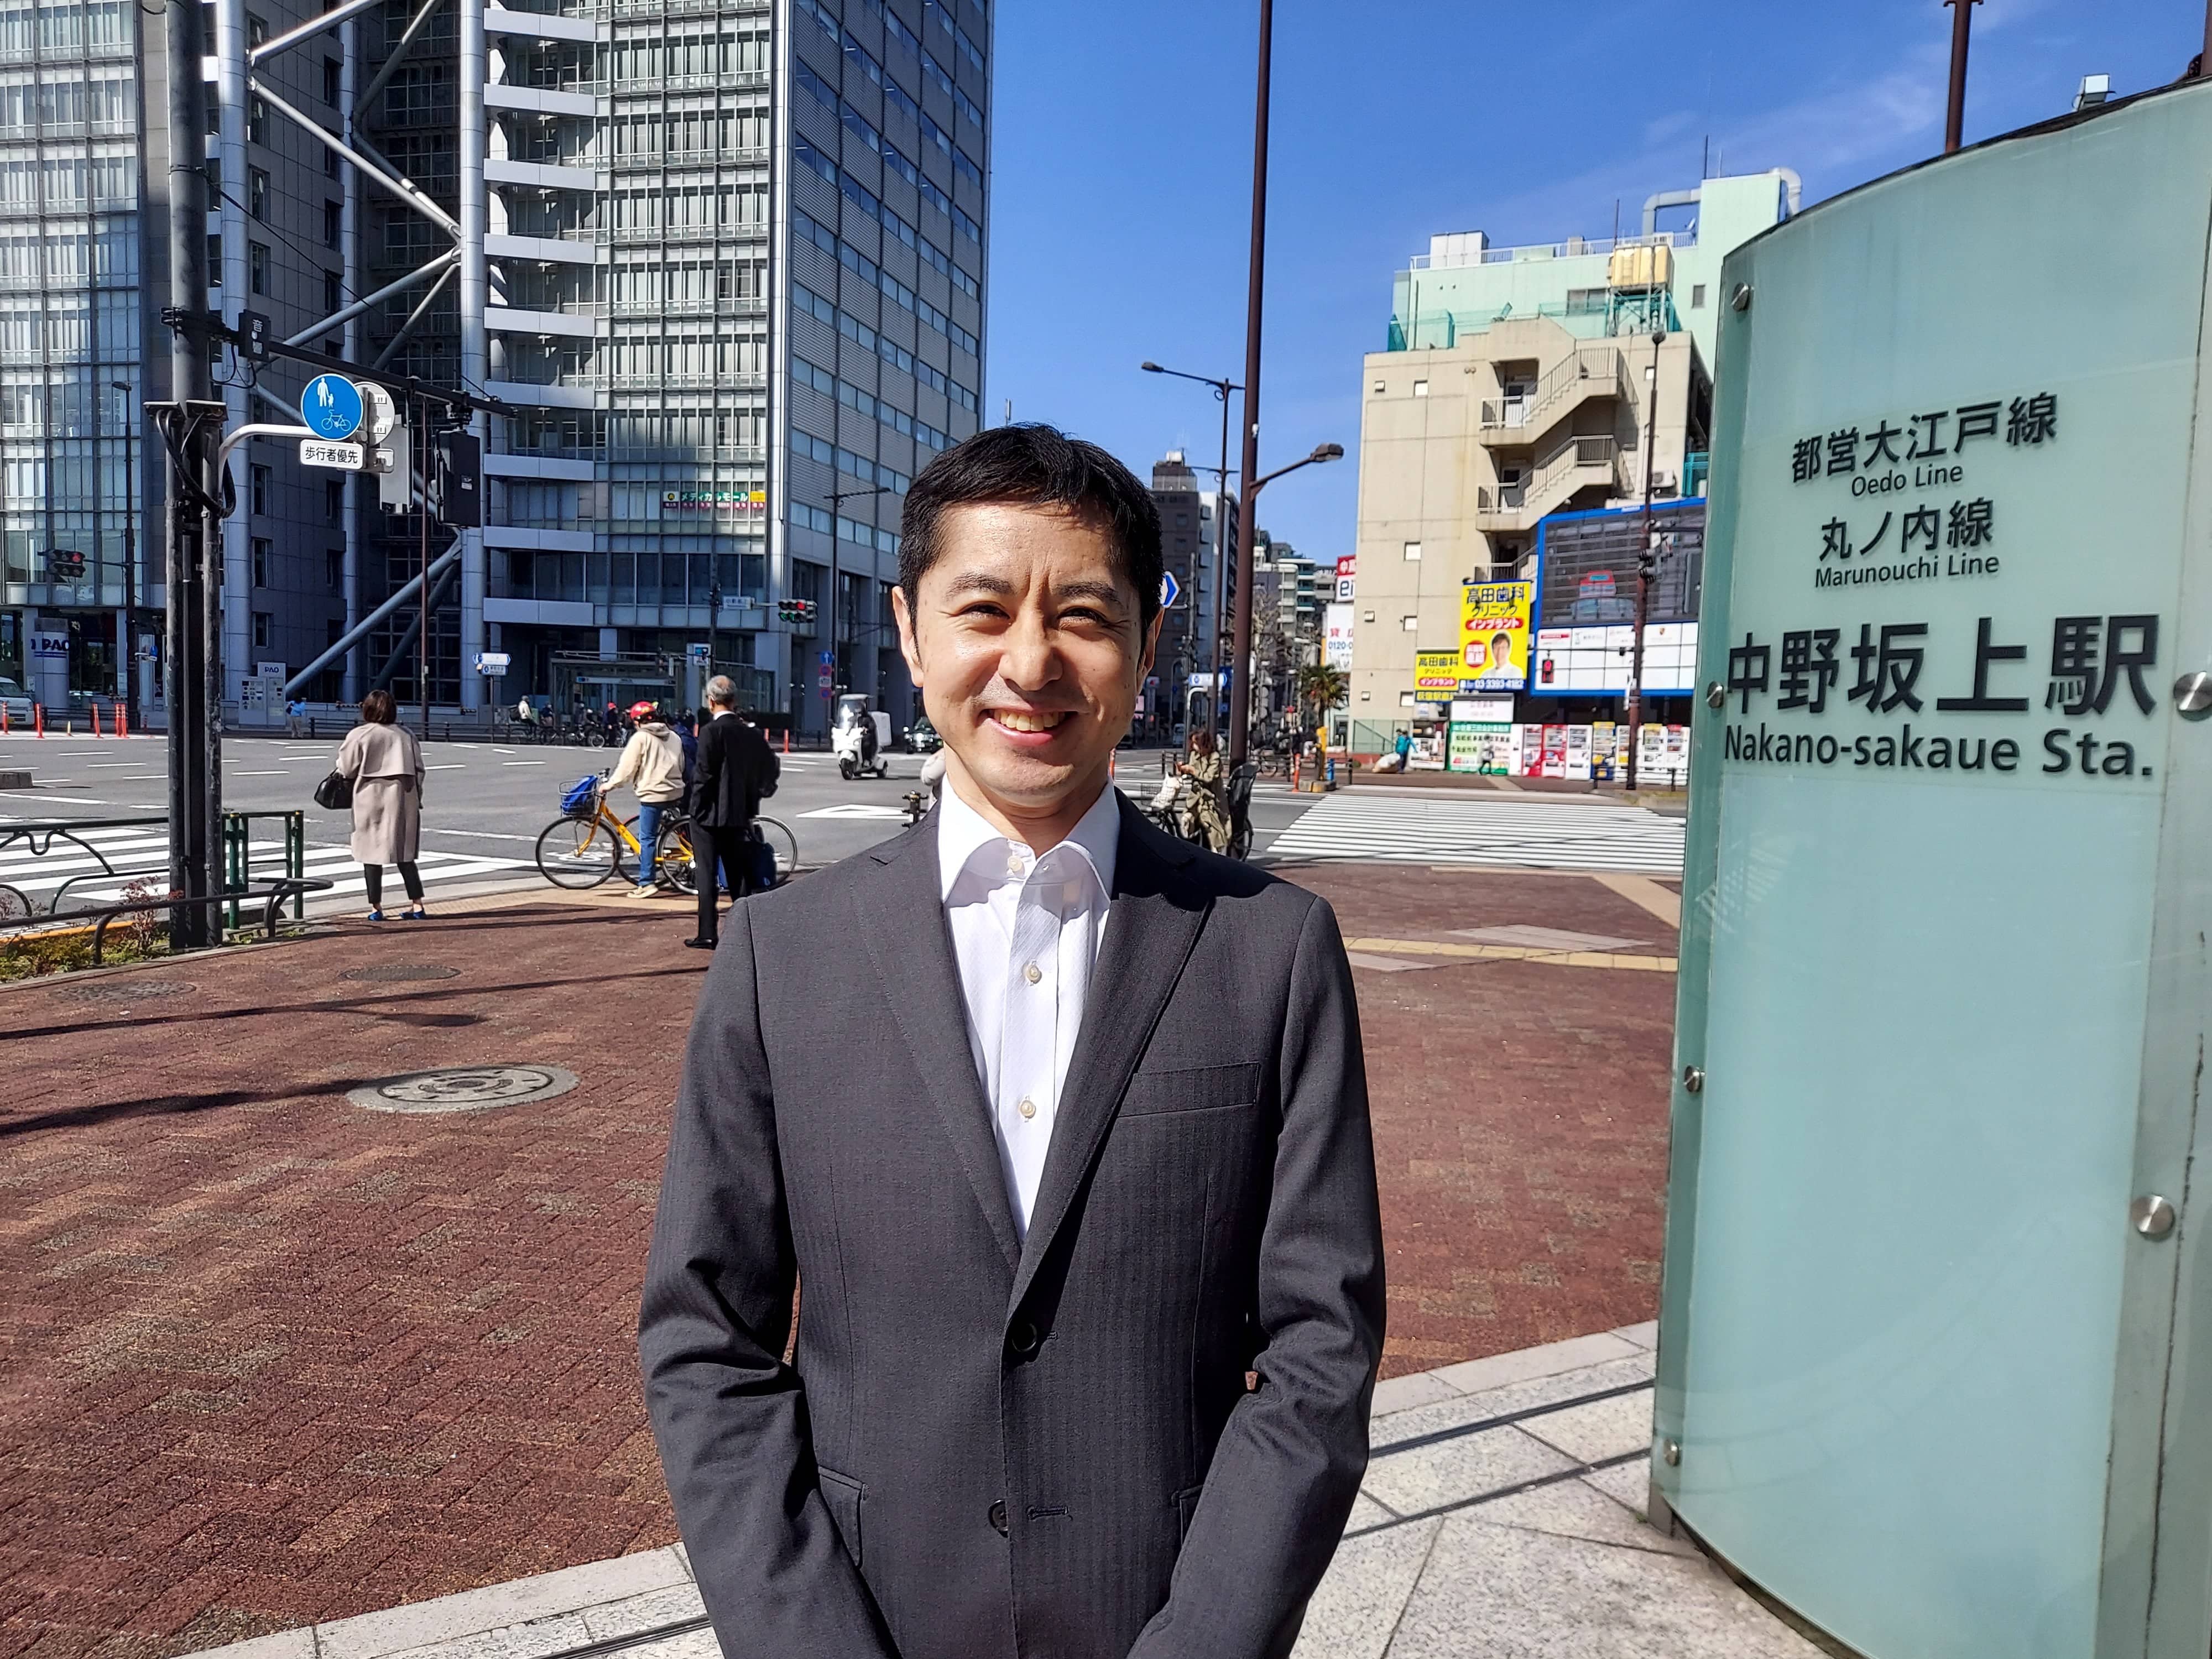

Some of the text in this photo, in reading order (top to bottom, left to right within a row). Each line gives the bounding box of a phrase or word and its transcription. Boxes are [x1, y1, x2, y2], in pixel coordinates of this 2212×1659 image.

[305, 446, 359, 464] 歩行者優先
[1792, 391, 2059, 484] 都営大江戸線
[1851, 462, 1964, 498] Oedo Line
[1819, 497, 1995, 562] 丸ノ内線
[1815, 553, 2000, 588] Marunouchi Line
[1469, 618, 1520, 629] インプラント
[1726, 614, 2161, 717] 中野坂上駅
[1725, 723, 2153, 776] Nakano-sakaue Sta.
